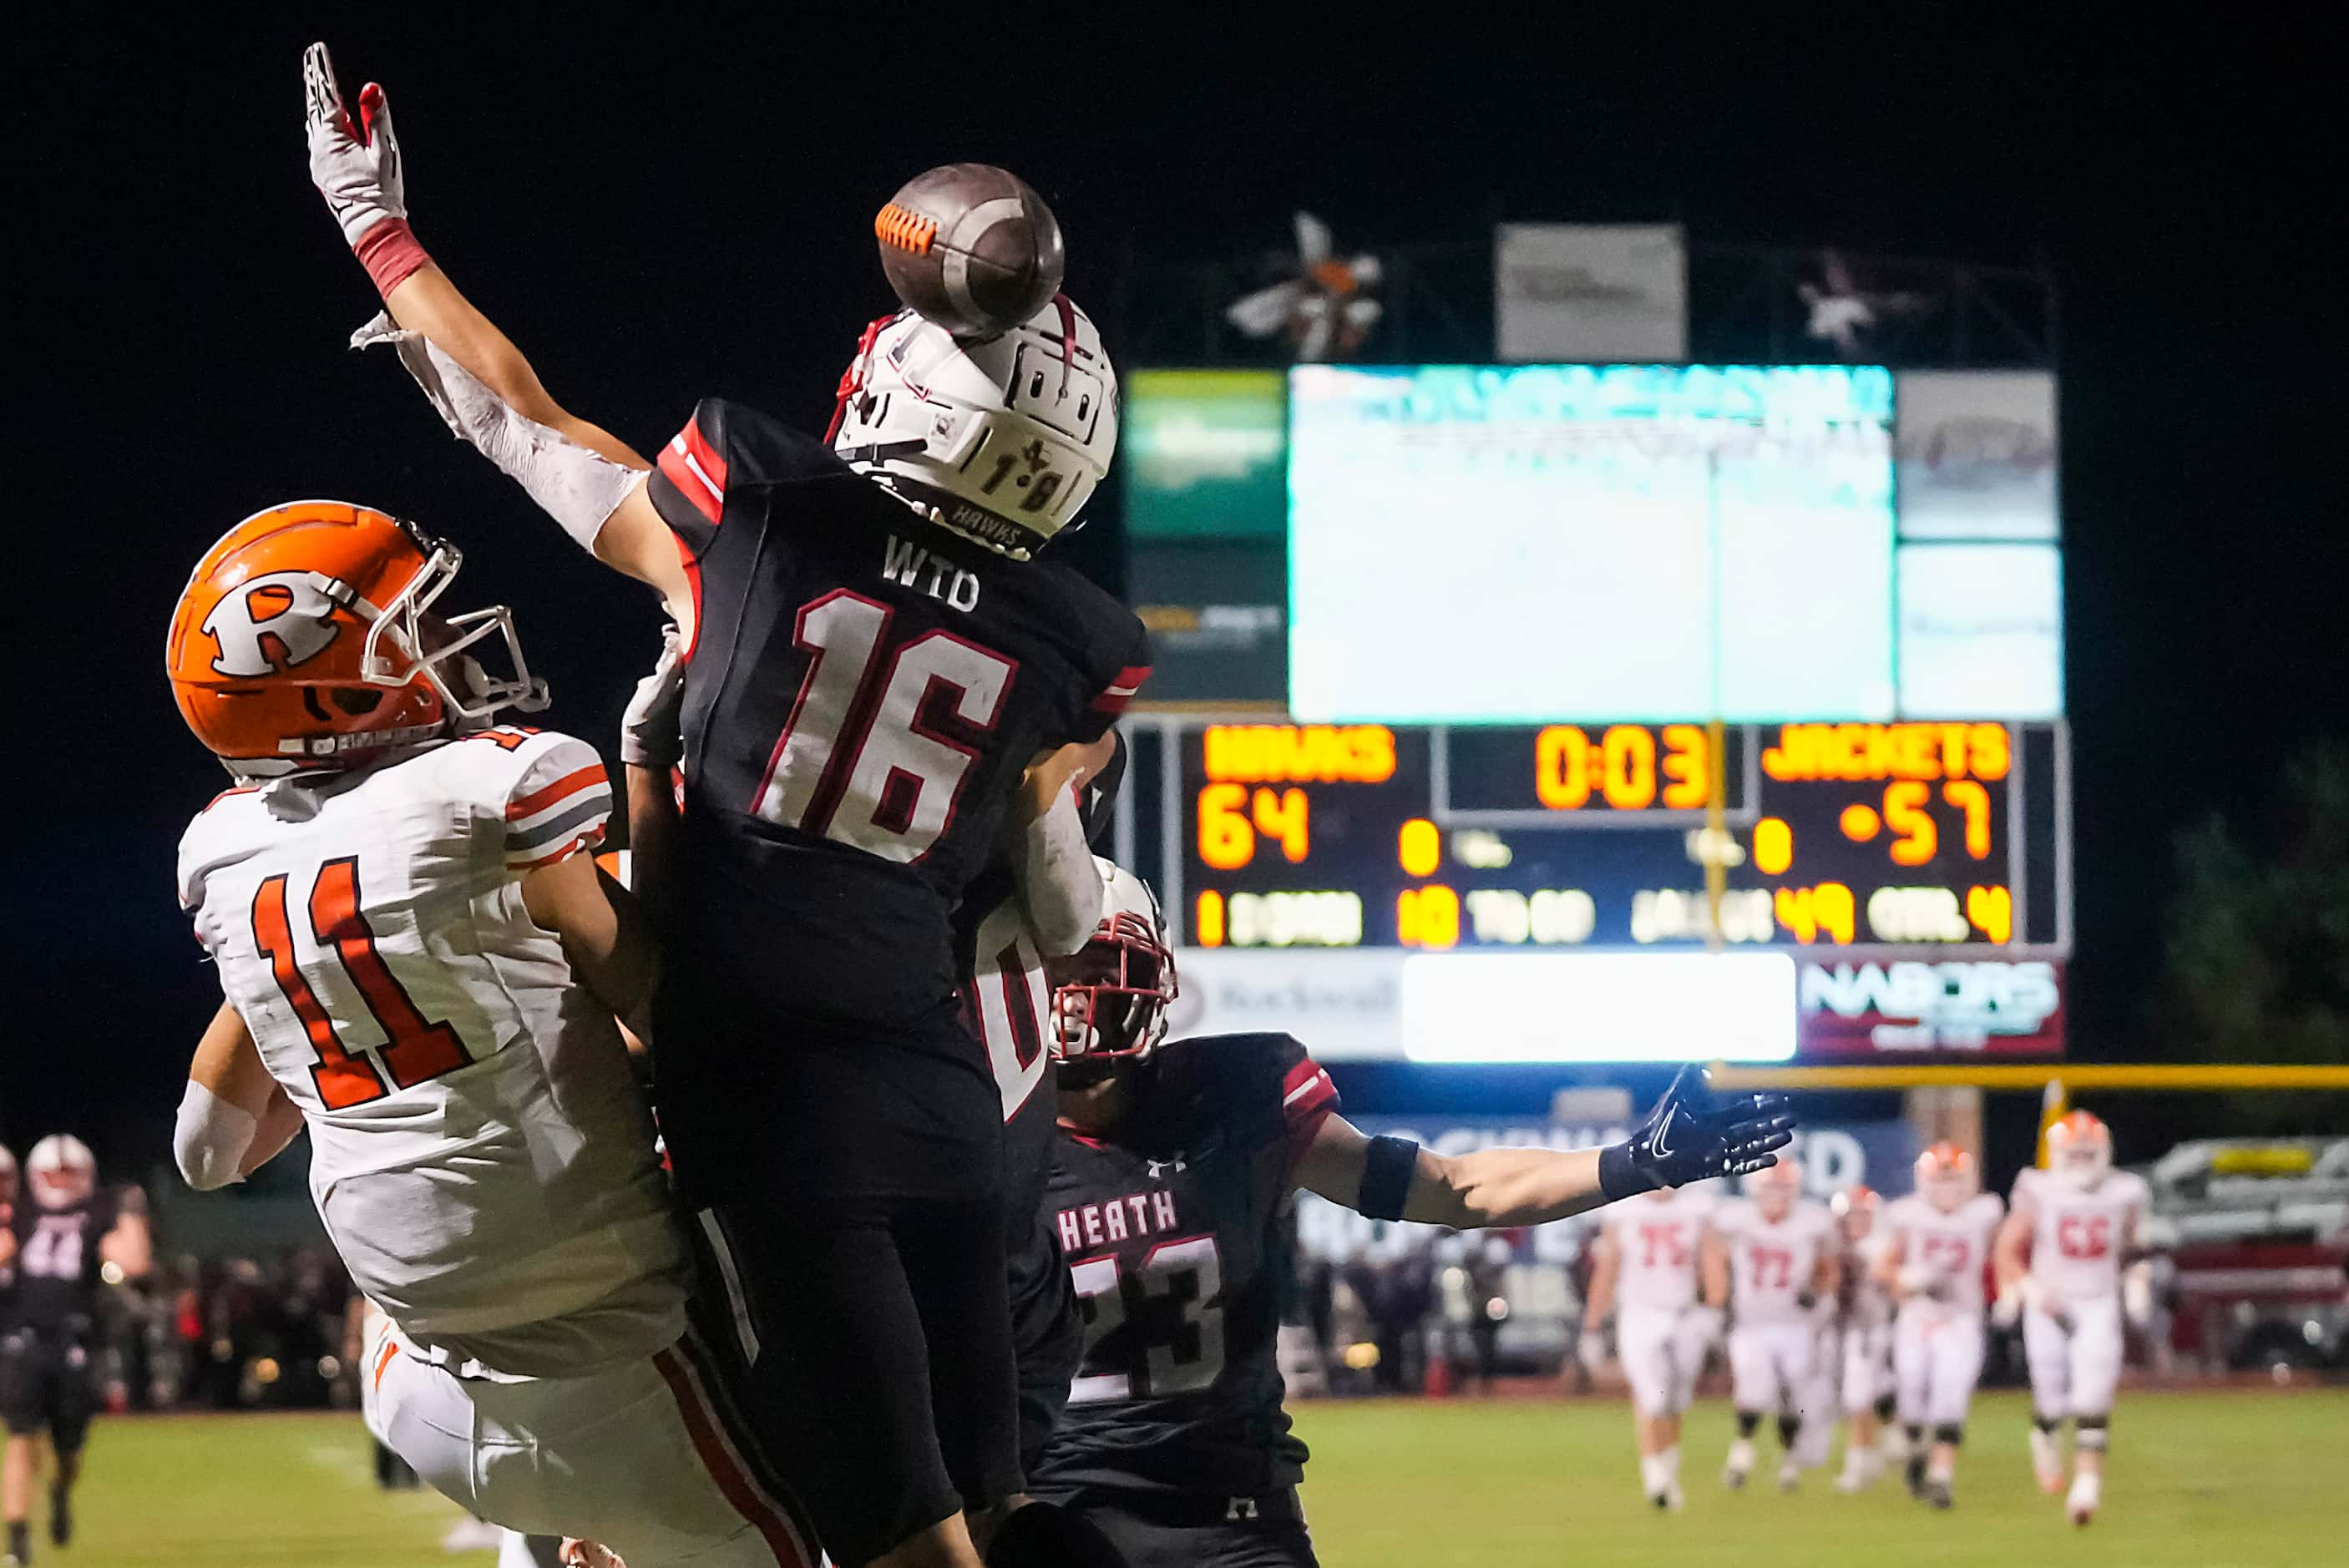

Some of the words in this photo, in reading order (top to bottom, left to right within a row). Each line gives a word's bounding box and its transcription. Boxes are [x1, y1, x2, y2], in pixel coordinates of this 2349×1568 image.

[751, 586, 1020, 866] 16
[1761, 723, 2011, 781] JACKETS
[1535, 724, 1709, 810] 0:03
[1198, 783, 1309, 870] 64
[1197, 889, 1224, 948] 1
[1396, 884, 1460, 949] 10
[1774, 882, 1855, 945] 49
[1967, 885, 2012, 944] 4
[251, 854, 476, 1112] 11
[1056, 1190, 1177, 1253] HEATH
[1066, 1232, 1226, 1404] 23
